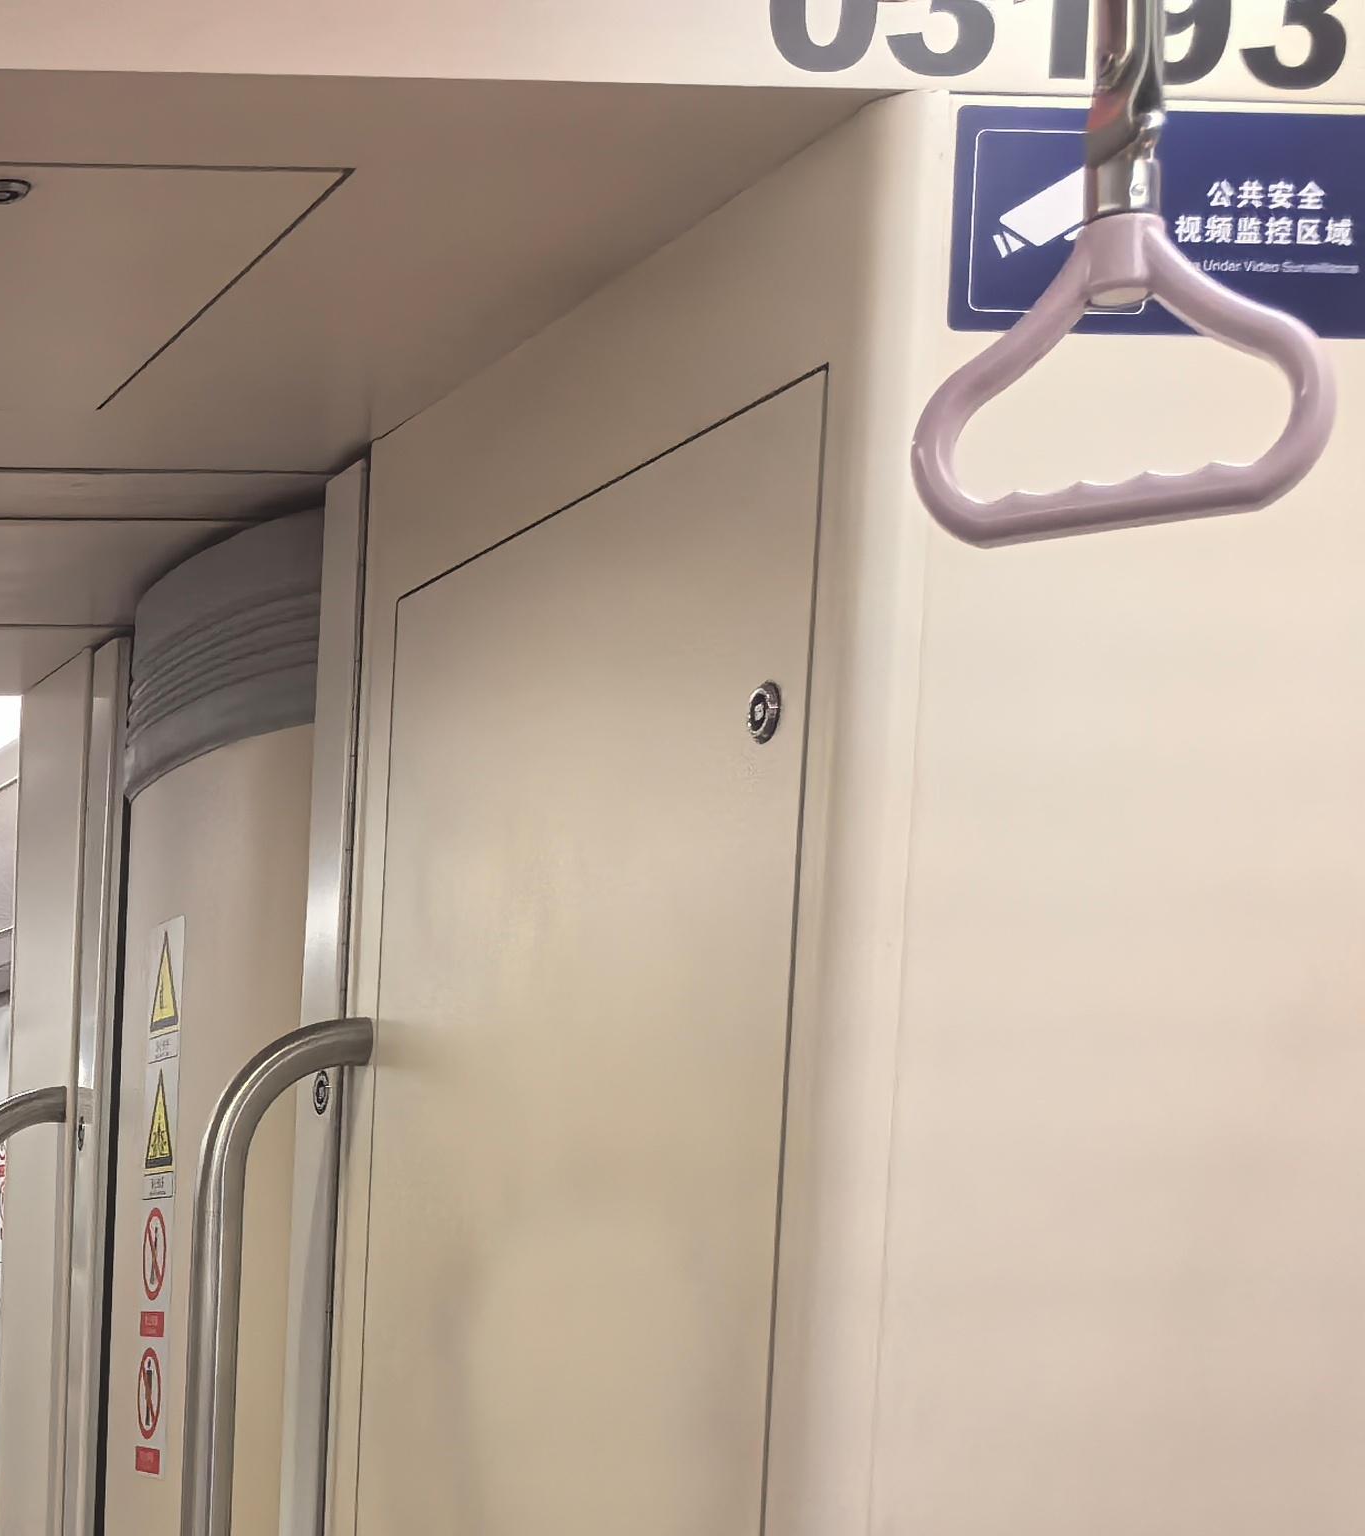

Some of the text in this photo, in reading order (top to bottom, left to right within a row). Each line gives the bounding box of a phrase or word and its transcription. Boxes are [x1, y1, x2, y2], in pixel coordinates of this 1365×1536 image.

[1206, 179, 1326, 210] 公共安全
[1174, 215, 1355, 246] 视频监控区域
[1204, 259, 1242, 272] Under
[1244, 260, 1279, 272] Video
